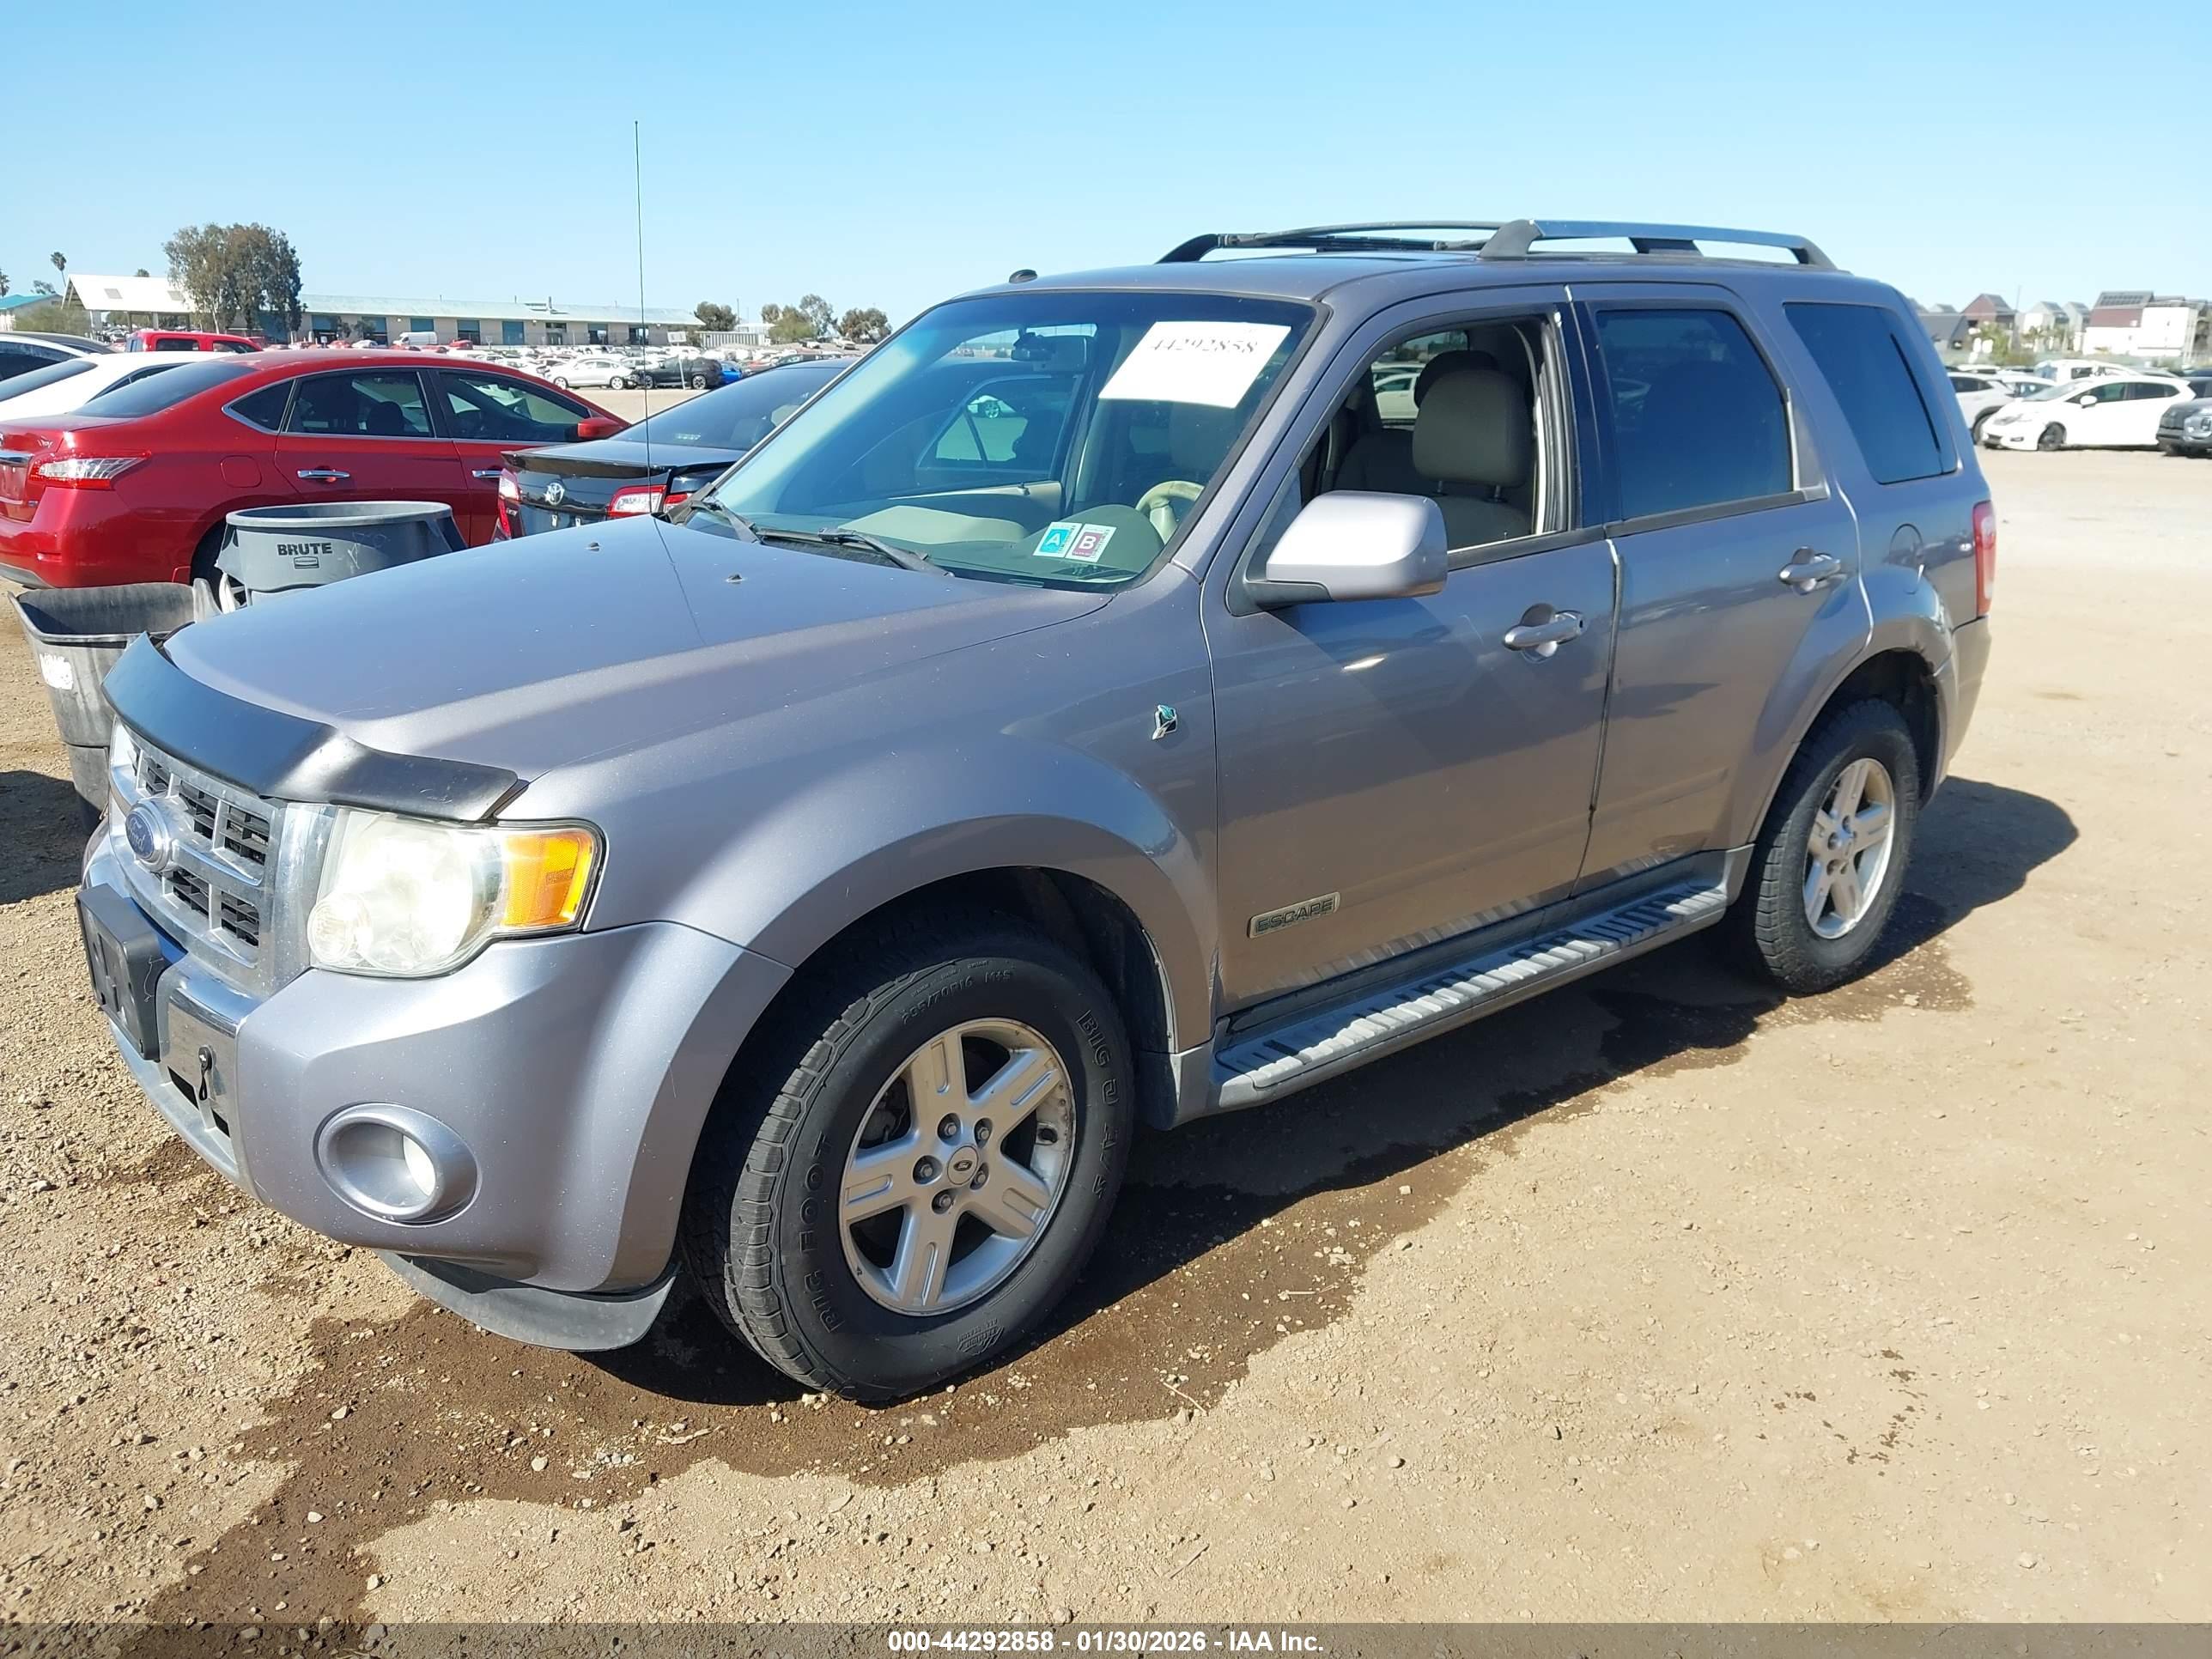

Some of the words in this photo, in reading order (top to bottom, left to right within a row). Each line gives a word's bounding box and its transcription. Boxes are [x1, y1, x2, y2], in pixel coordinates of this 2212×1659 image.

[276, 543, 333, 556] BRUTE
[1045, 532, 1060, 546] A
[1079, 535, 1097, 550] B
[1256, 897, 1334, 933] ESCAPE
[1075, 1009, 1111, 1066] BIG
[799, 1130, 833, 1253] FOOT
[804, 1270, 846, 1334] BIG
